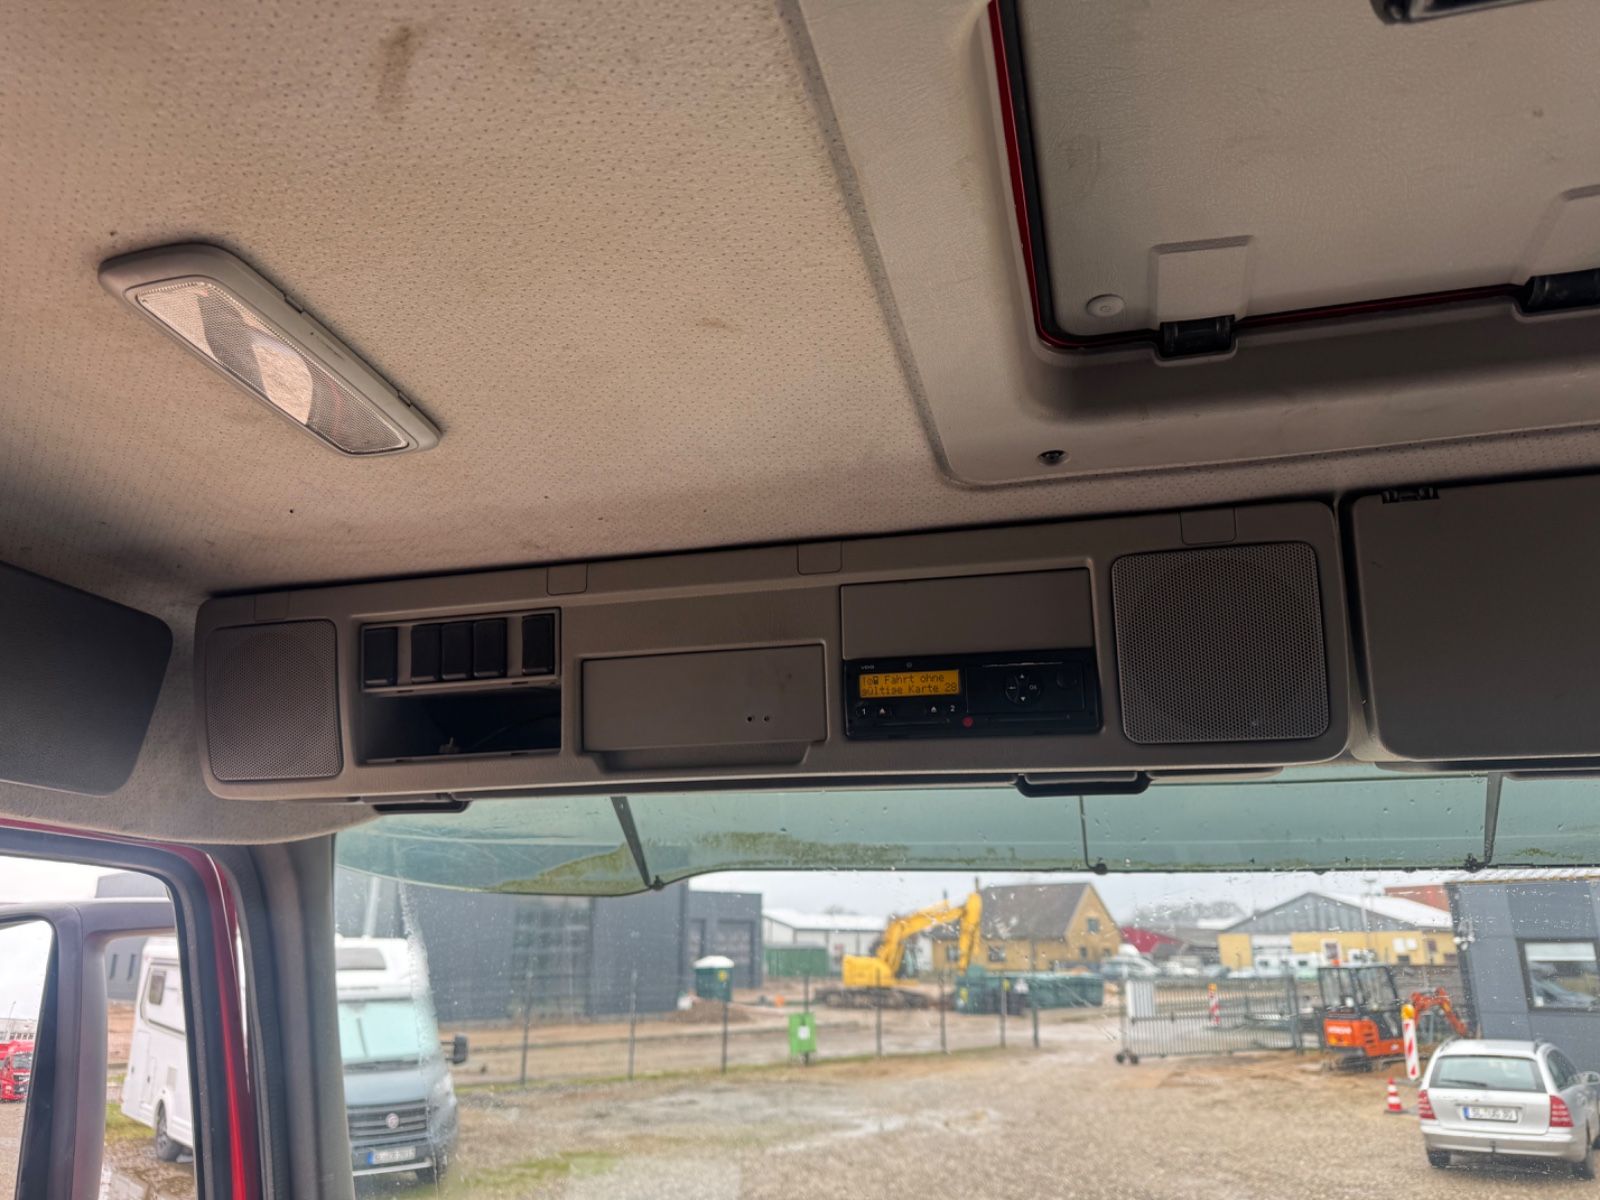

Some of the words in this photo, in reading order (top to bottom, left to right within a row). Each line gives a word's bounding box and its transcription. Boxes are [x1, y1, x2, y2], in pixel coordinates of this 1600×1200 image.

[884, 674, 915, 685] Fahrt
[920, 673, 945, 684] ohne
[906, 684, 940, 694] Karte
